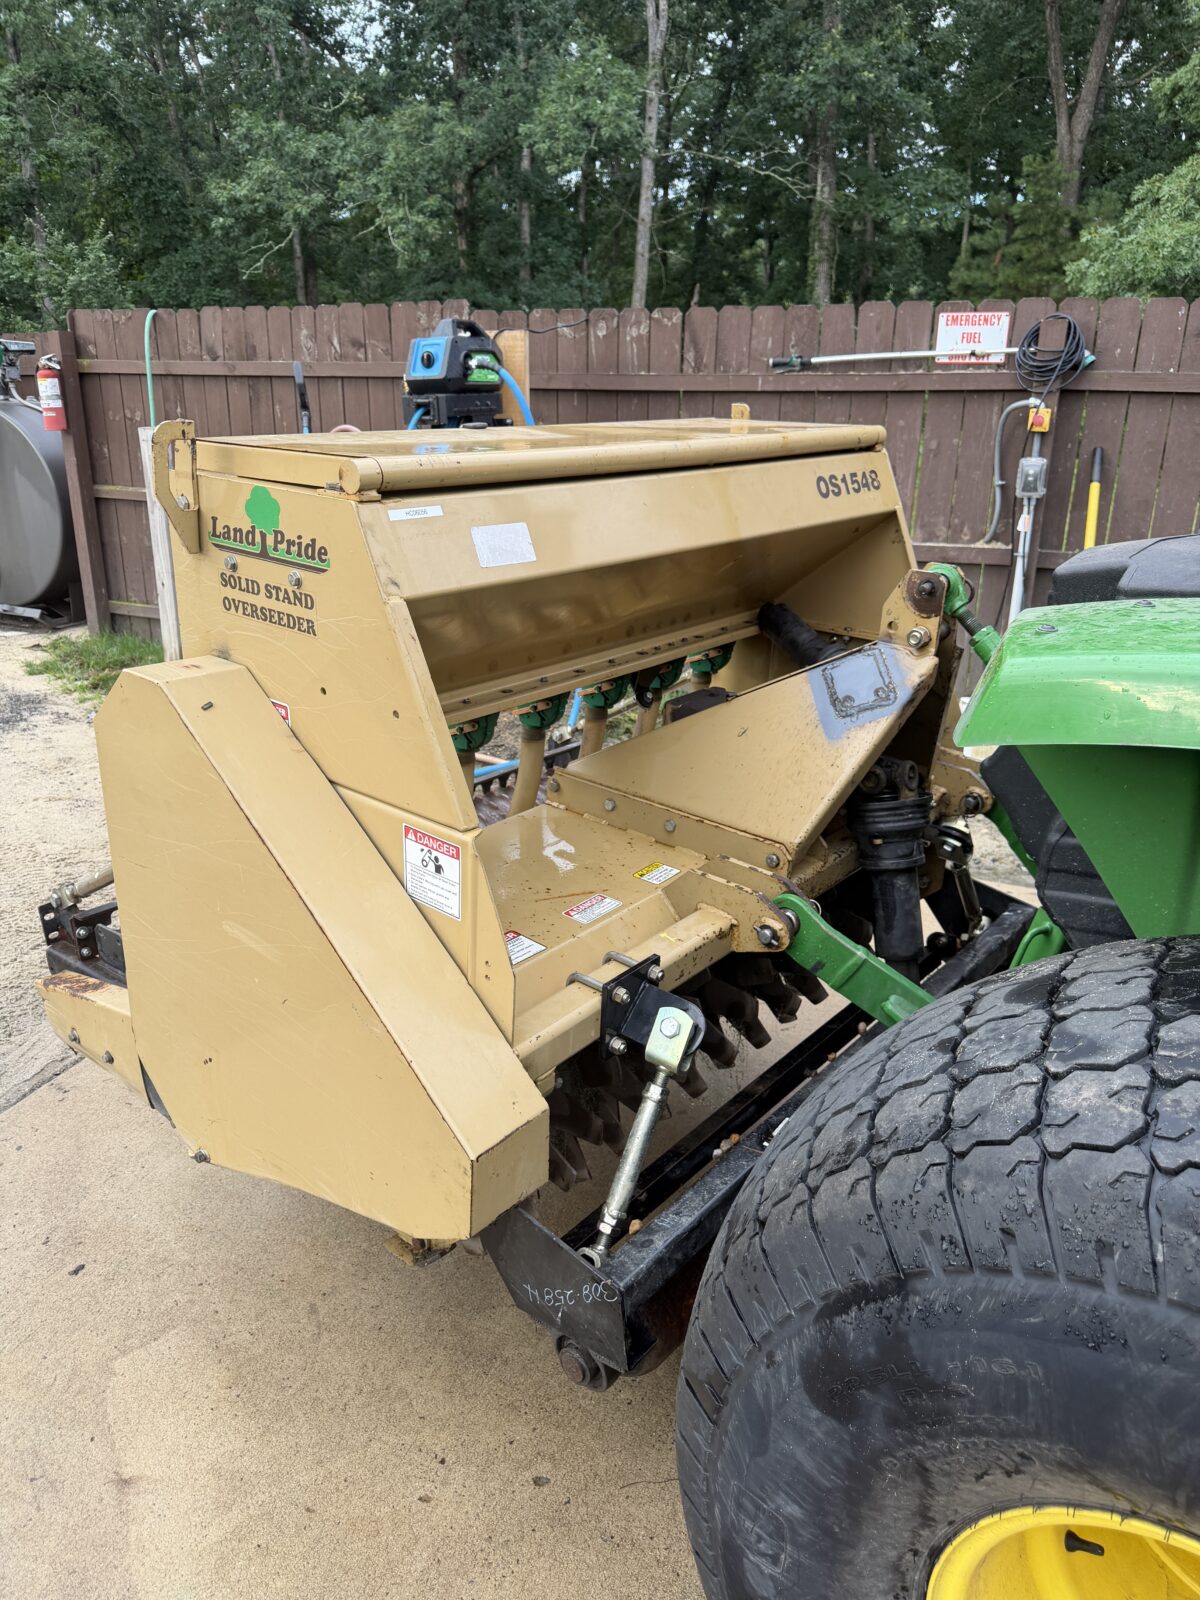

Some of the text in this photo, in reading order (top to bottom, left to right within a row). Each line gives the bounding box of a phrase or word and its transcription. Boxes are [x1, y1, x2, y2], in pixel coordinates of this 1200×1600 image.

[945, 314, 1003, 327] EMERGENCY
[961, 331, 982, 344] FUEL
[816, 469, 881, 499] OS1548
[210, 516, 328, 564] Land Pride
[220, 572, 315, 611] SOLID STAND
[222, 596, 317, 637] OVERSEEDER
[417, 832, 457, 858] DANGER
